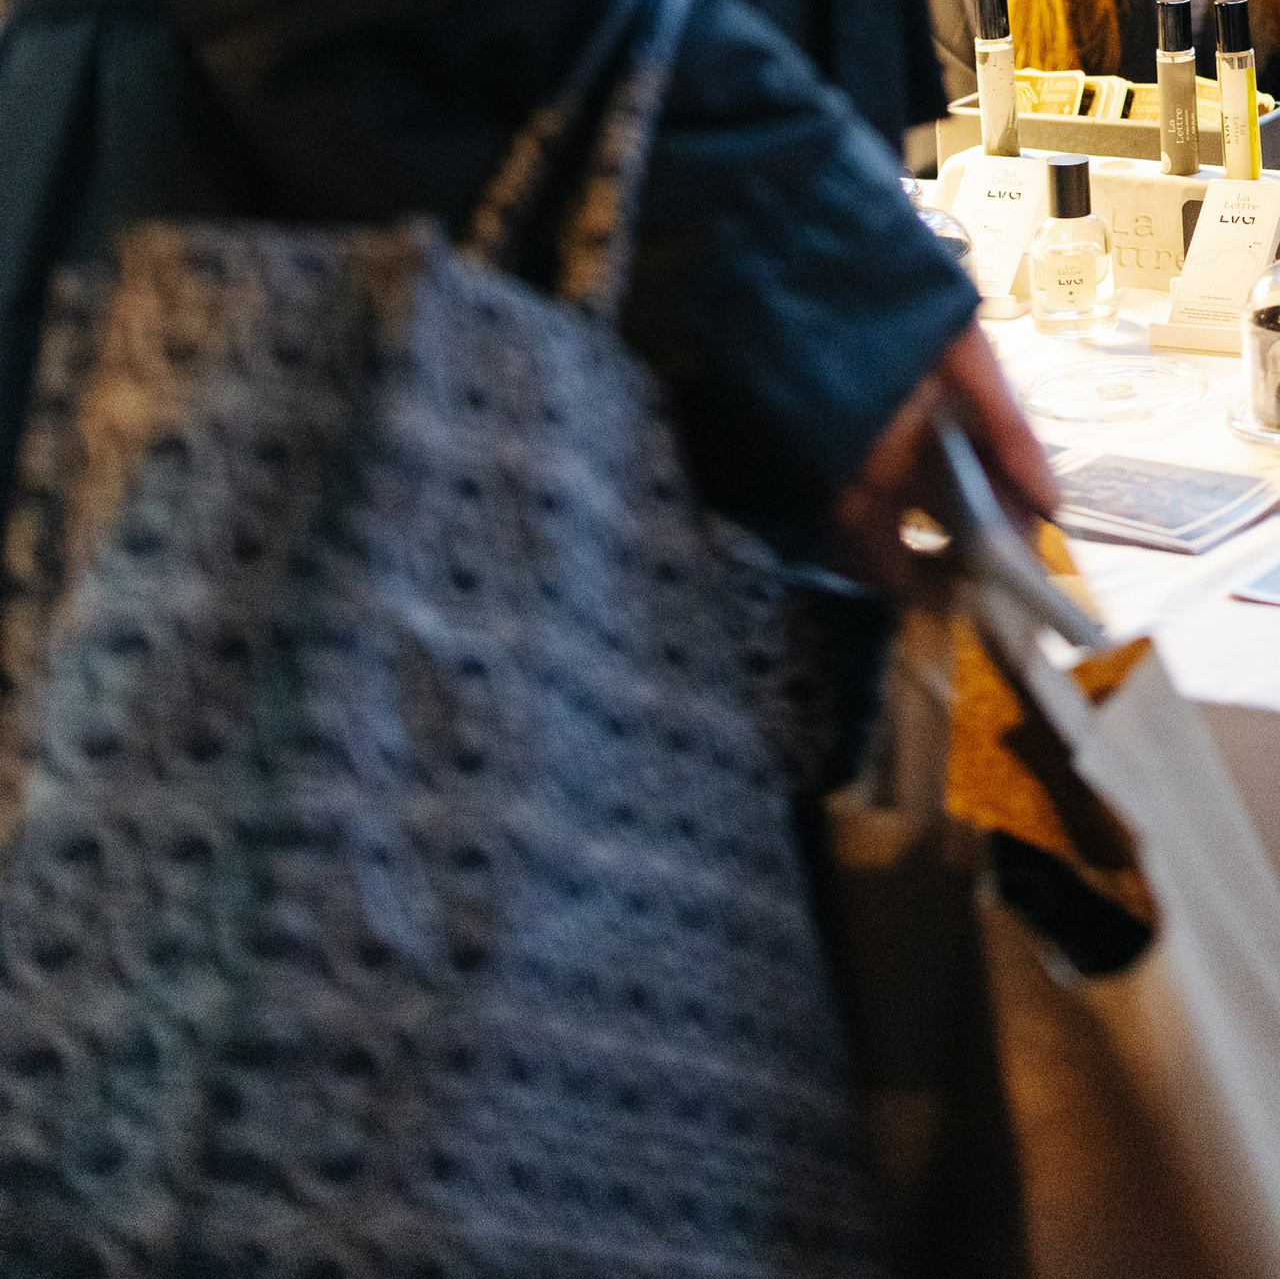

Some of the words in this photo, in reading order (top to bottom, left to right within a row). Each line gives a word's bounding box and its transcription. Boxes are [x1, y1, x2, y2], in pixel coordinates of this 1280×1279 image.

[1168, 119, 1177, 133] La
[1176, 108, 1185, 144] Lettre
[1223, 201, 1260, 211] Lettre
[1235, 193, 1250, 202] La
[1112, 206, 1153, 237] La
[1115, 244, 1184, 272] ttre
